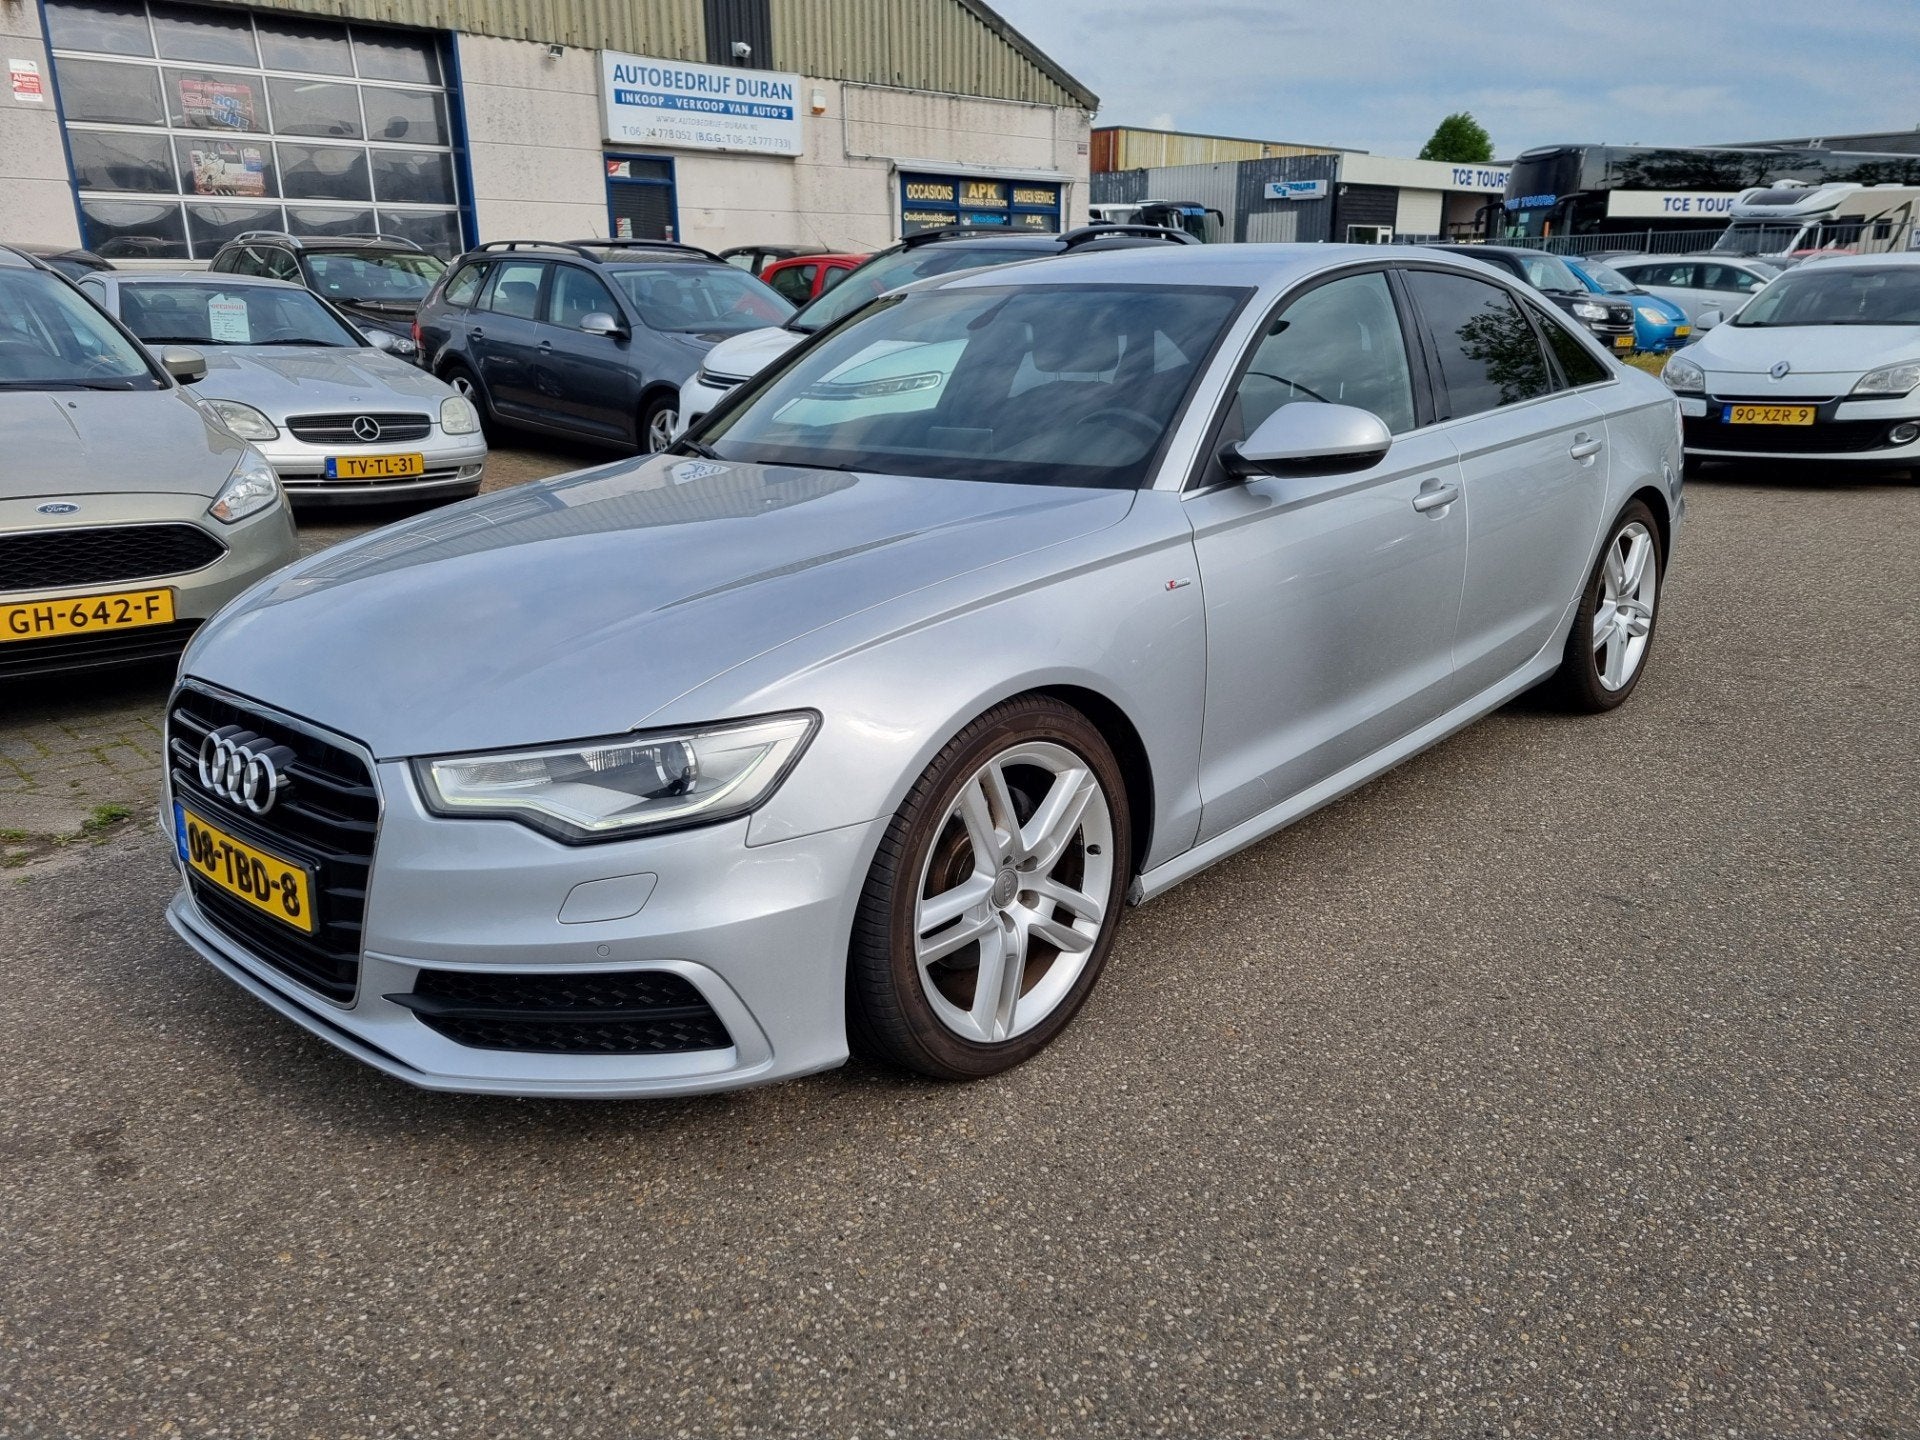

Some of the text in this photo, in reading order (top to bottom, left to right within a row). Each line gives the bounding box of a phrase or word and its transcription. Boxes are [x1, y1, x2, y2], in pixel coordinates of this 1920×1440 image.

[613, 64, 793, 100] AUTOBEDRIJF DURAN
[621, 92, 665, 105] INKOOP
[676, 98, 725, 112] VERKOOP
[728, 103, 749, 114] VAN
[752, 105, 788, 118] AUTO'S
[1452, 168, 1473, 186] TCE
[906, 184, 954, 201] OCCASIONS
[968, 183, 998, 199] APK
[1521, 194, 1557, 207] TOURS
[1663, 197, 1691, 212] TCE
[1025, 215, 1043, 225] APK
[347, 457, 414, 475] TV-TL-31
[8, 595, 160, 634] GH-642-F
[188, 821, 300, 917] 08-TBD-8
